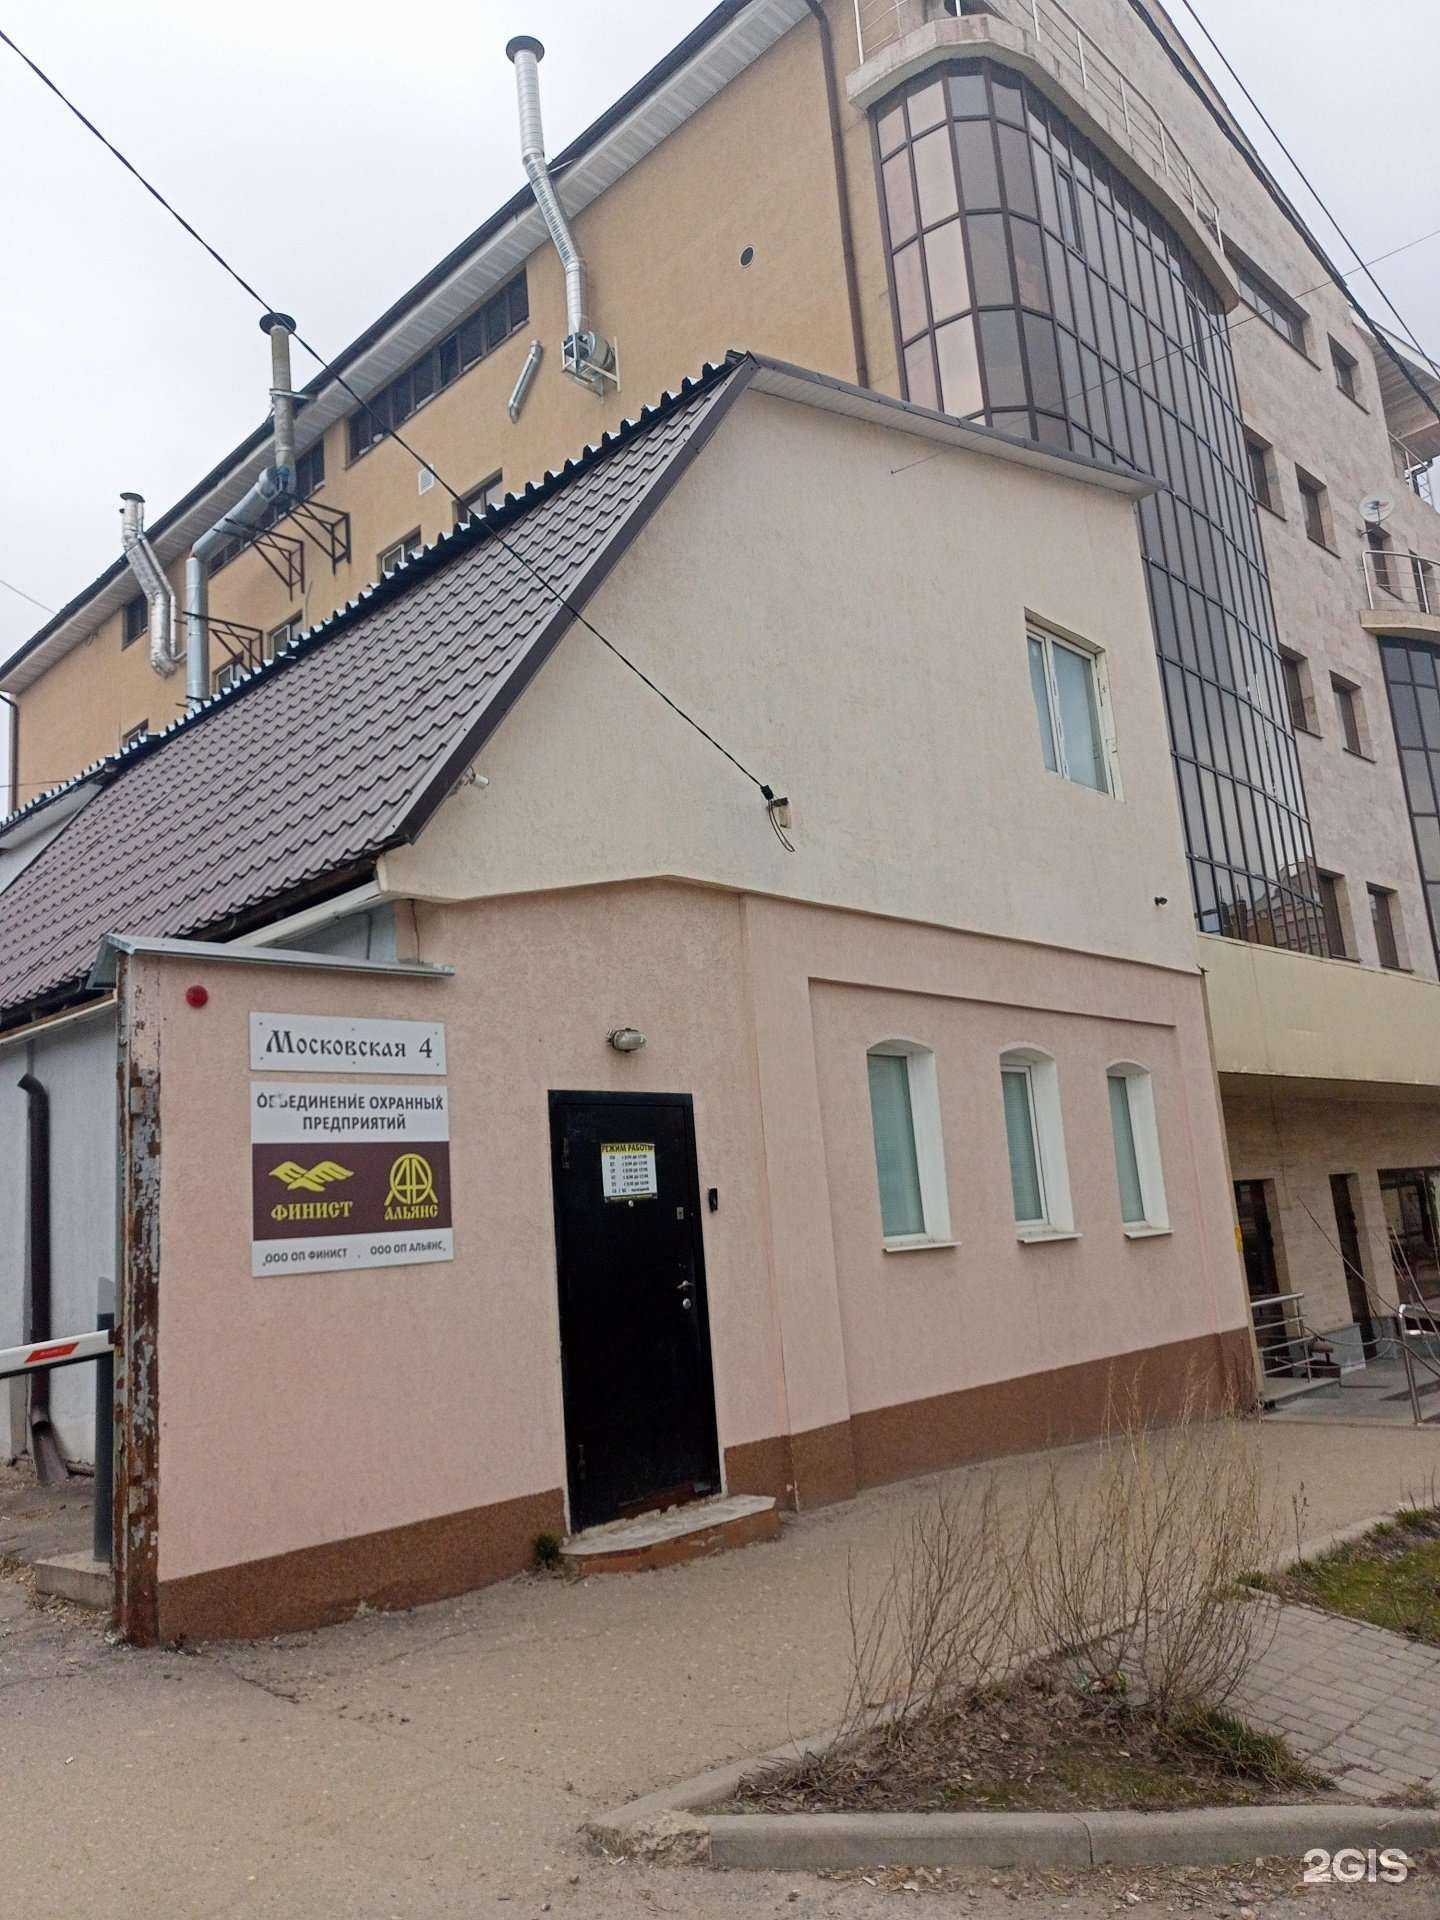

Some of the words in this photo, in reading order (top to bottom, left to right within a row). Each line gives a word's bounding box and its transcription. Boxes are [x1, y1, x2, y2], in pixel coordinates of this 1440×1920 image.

[266, 1030, 407, 1057] Московская
[419, 1037, 432, 1058] 4
[369, 1095, 444, 1111] ОХРАННЫХ
[303, 1114, 406, 1132] ПРЕДПРИЯТИЙ
[271, 1201, 353, 1221] ФИНИСТ
[384, 1204, 439, 1221] АЛЬЯНС
[265, 1253, 288, 1263] ООО
[291, 1251, 306, 1261] ОП
[307, 1248, 348, 1260] ФИНИСТ
[370, 1245, 391, 1255] ООО
[393, 1244, 407, 1254] ОП
[409, 1240, 442, 1251] АЛЬЯНС
